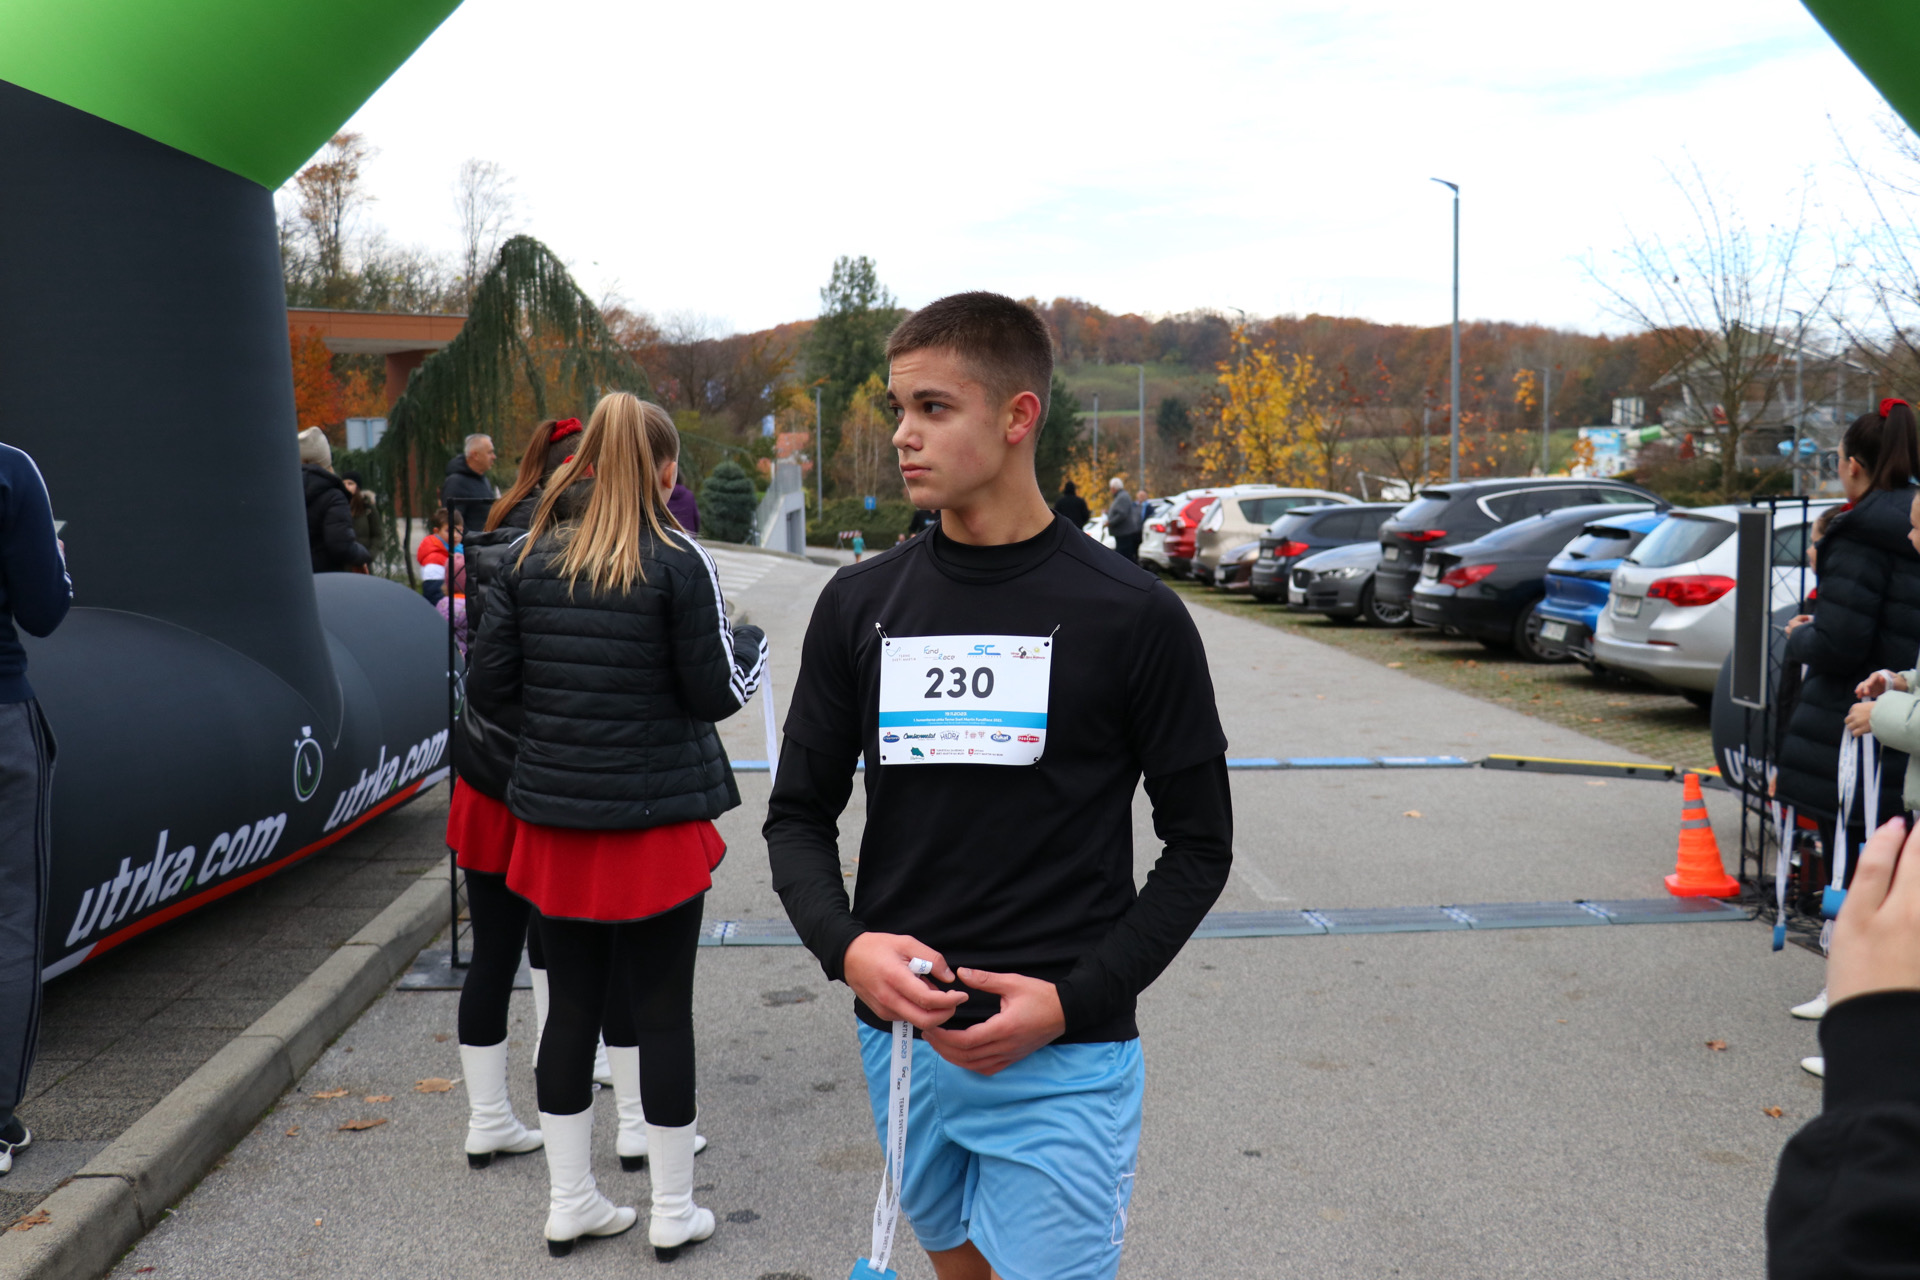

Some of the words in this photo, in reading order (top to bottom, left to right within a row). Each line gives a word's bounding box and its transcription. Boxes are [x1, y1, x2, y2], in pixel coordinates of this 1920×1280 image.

[924, 667, 995, 699] 230
[323, 728, 449, 832] utrka.com
[65, 812, 287, 947] utrka.com
